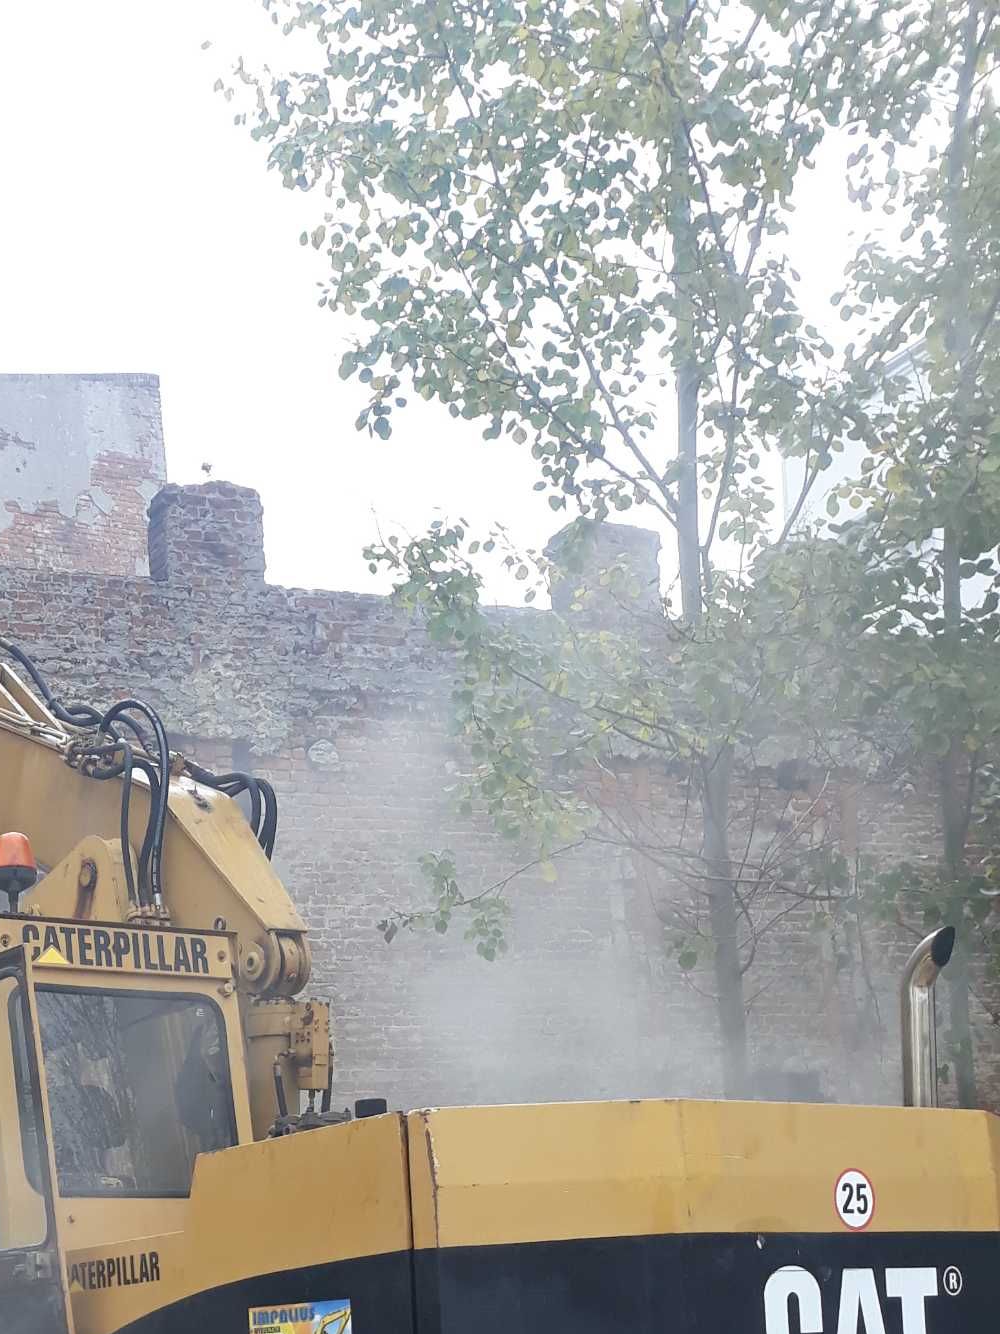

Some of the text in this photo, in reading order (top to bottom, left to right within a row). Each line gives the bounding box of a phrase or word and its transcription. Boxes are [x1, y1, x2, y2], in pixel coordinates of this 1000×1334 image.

[22, 924, 209, 974] CATERPILLAR
[842, 1182, 869, 1215] 25
[67, 1251, 161, 1291] ATERPILLAR
